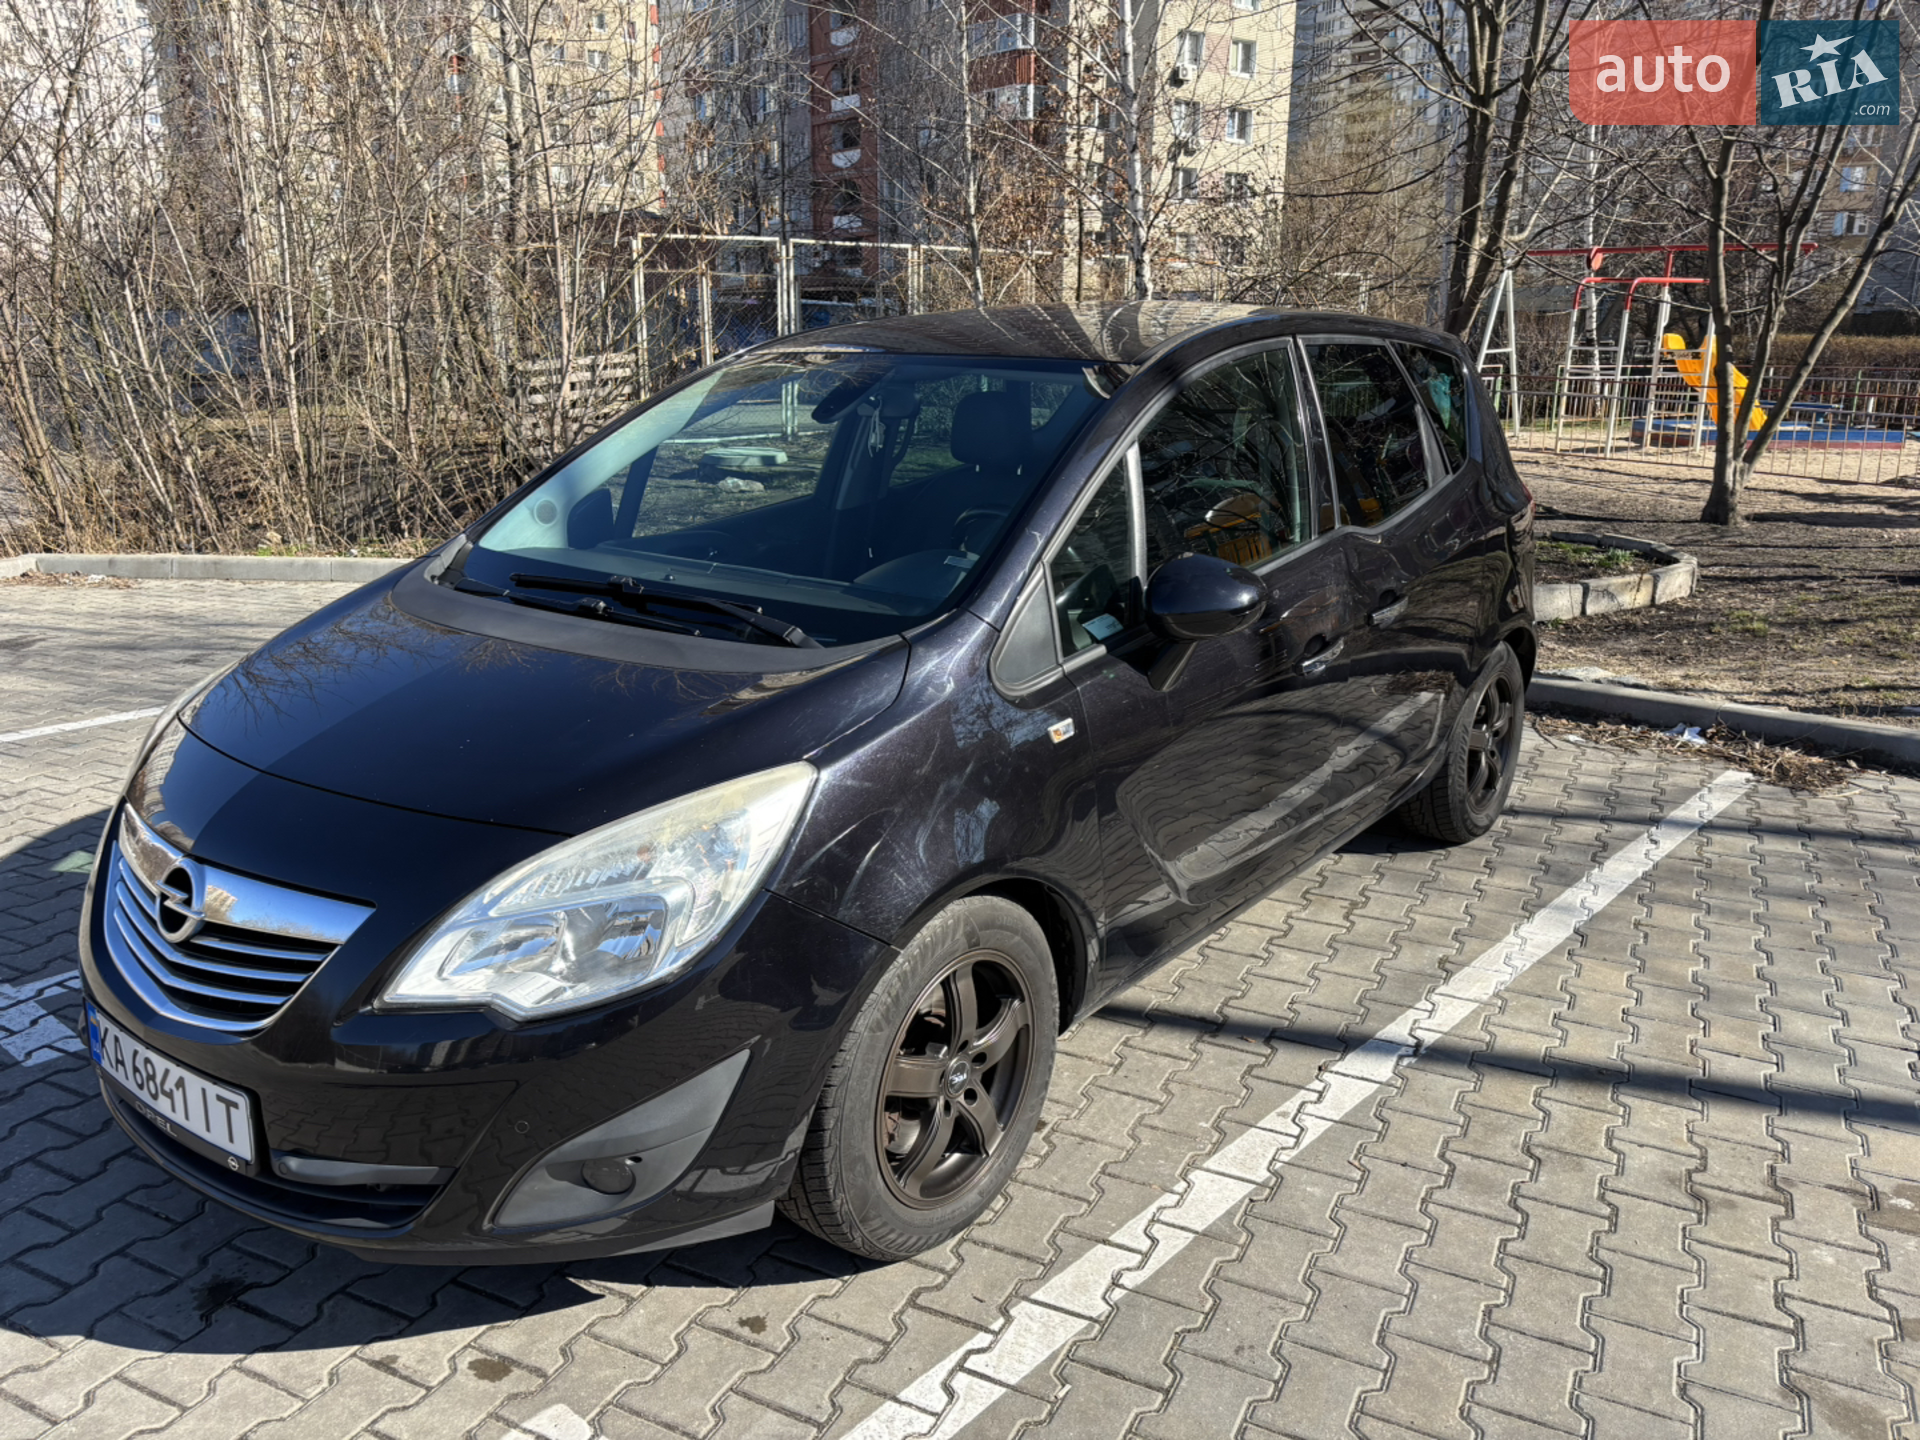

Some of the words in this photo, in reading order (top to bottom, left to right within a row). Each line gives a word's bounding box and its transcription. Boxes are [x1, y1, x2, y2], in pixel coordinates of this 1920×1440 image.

[100, 1026, 129, 1081] KA
[132, 1048, 190, 1122] 6841
[201, 1086, 240, 1144] IT
[135, 1100, 178, 1137] OPEL
